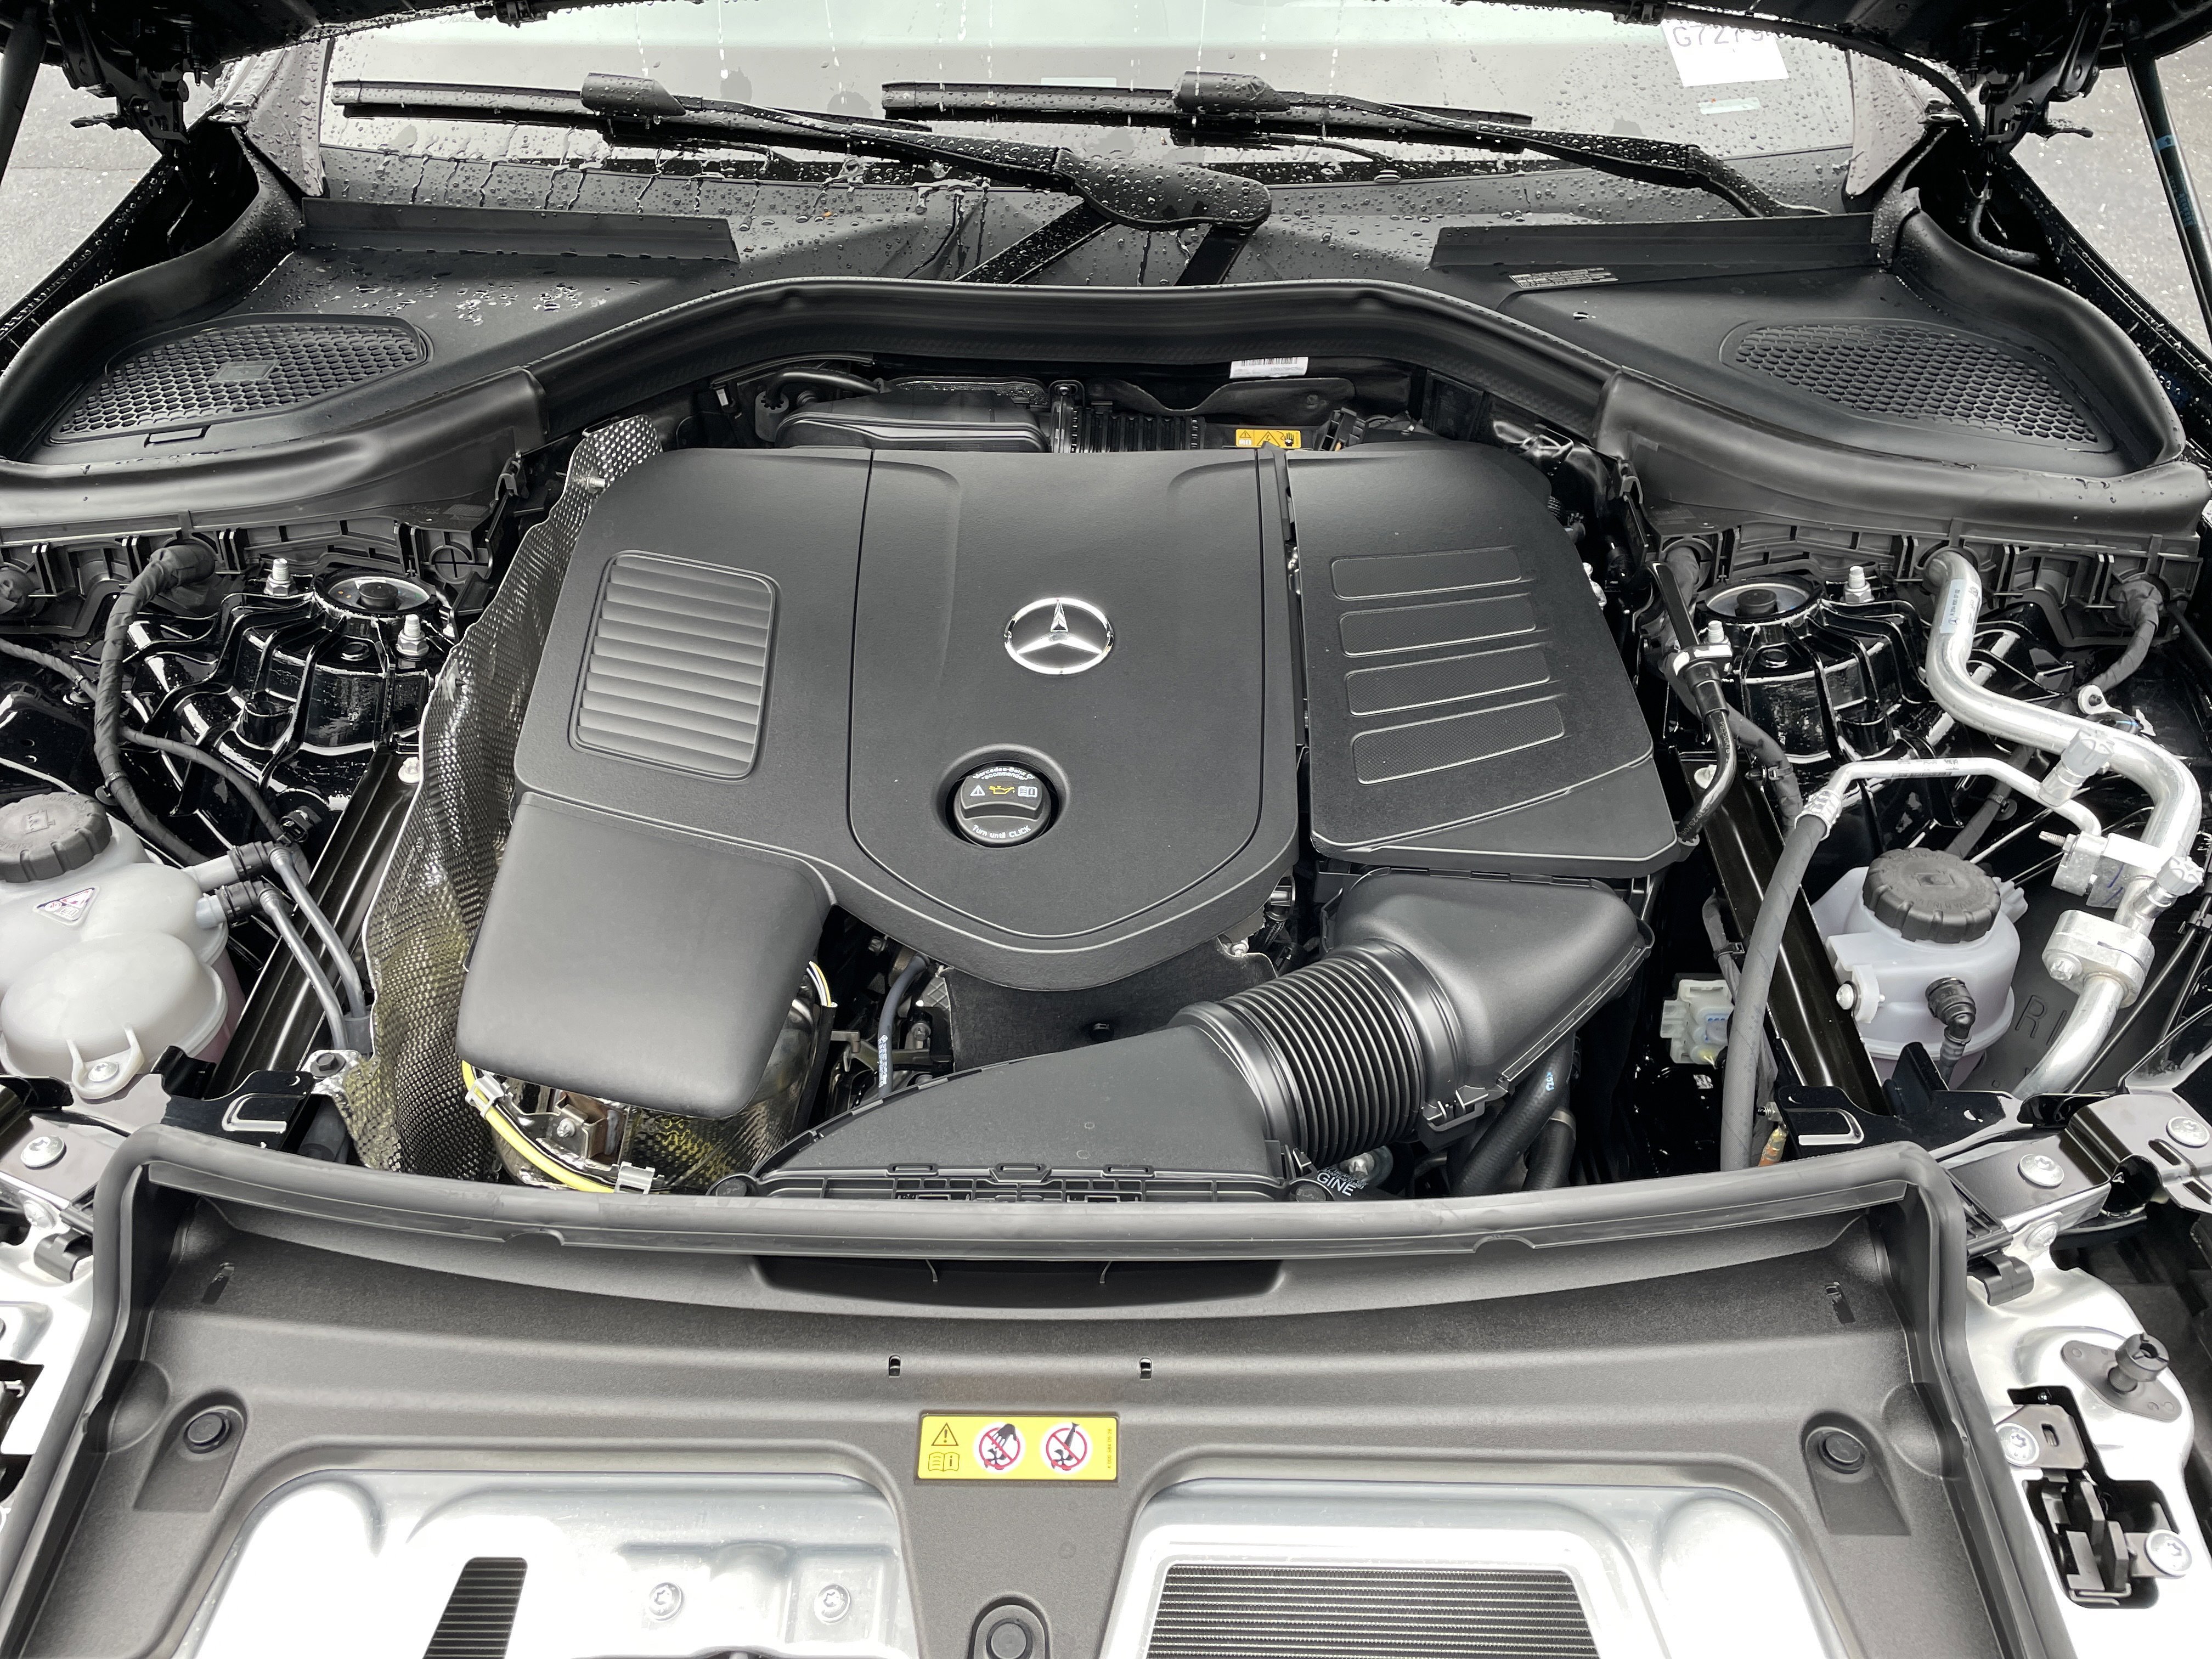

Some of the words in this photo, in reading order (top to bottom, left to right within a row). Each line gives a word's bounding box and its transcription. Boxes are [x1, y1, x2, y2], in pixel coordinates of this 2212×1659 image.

[973, 824, 988, 836] Turn
[1009, 825, 1031, 837] CLICK
[1317, 1172, 1356, 1197] GINE
